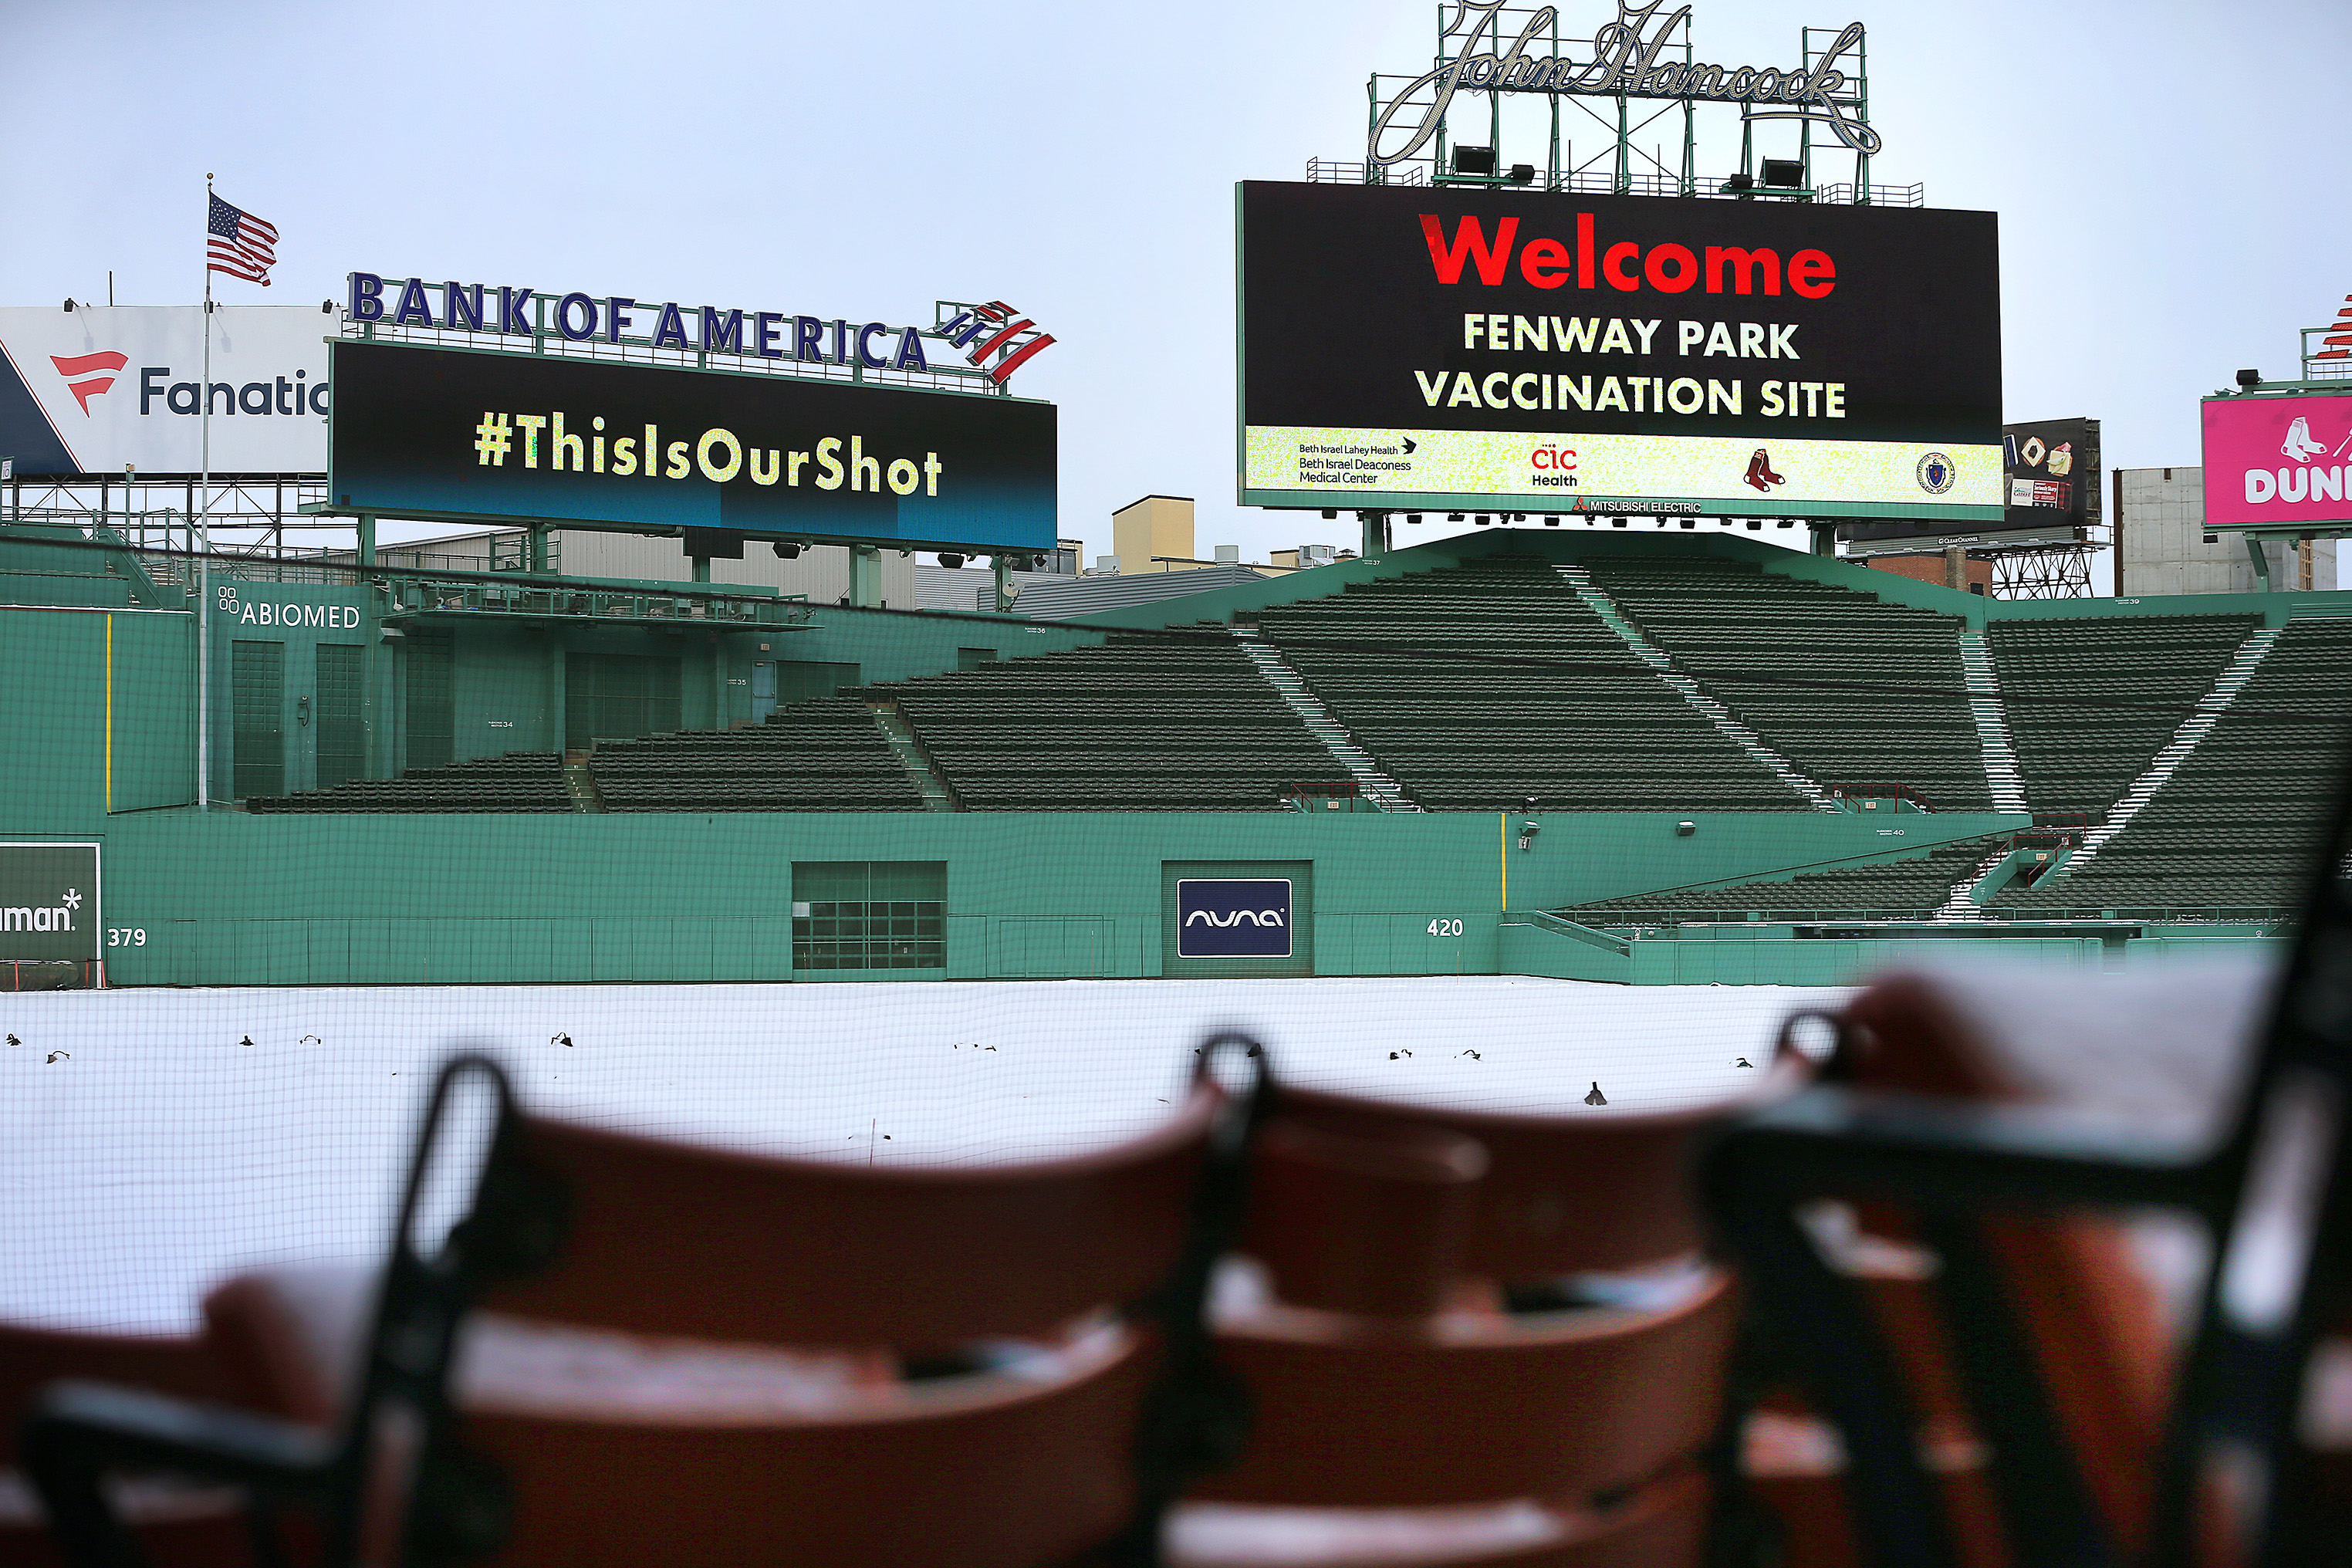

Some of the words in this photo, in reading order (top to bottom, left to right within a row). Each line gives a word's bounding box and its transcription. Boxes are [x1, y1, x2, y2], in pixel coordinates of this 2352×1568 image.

[1368, 0, 1574, 165] John
[1571, 0, 1882, 154] Hancock
[1418, 213, 1837, 299] Welcome
[347, 272, 535, 336] BANK
[553, 291, 636, 343] OF
[650, 302, 929, 372] AMERICA
[1465, 313, 1662, 355] FENWAY
[1678, 319, 1801, 360] PARK
[140, 367, 329, 416] Fanatic
[1414, 370, 1742, 416] VACCINATION
[1760, 380, 1846, 418] SITE
[474, 411, 942, 497] #ThisIsOurShot
[1299, 444, 1320, 453] Beth
[1320, 444, 1343, 454] Israel
[1344, 445, 1369, 456] Lahey
[1370, 445, 1397, 455] Health
[1299, 458, 1324, 468] Beth
[1326, 458, 1353, 470] Israel
[1355, 459, 1411, 471] Deaconess
[1299, 471, 1340, 483] Medical
[1343, 472, 1378, 484] Center
[1533, 475, 1577, 487] Health
[1590, 501, 1649, 512] MITSUBISHI
[1651, 502, 1701, 513] ELECTRIC
[240, 602, 360, 629] ABIOMED
[0, 906, 71, 932] man
[1184, 909, 1285, 928] nuna
[1427, 918, 1464, 937] 420
[107, 928, 147, 947] 379
